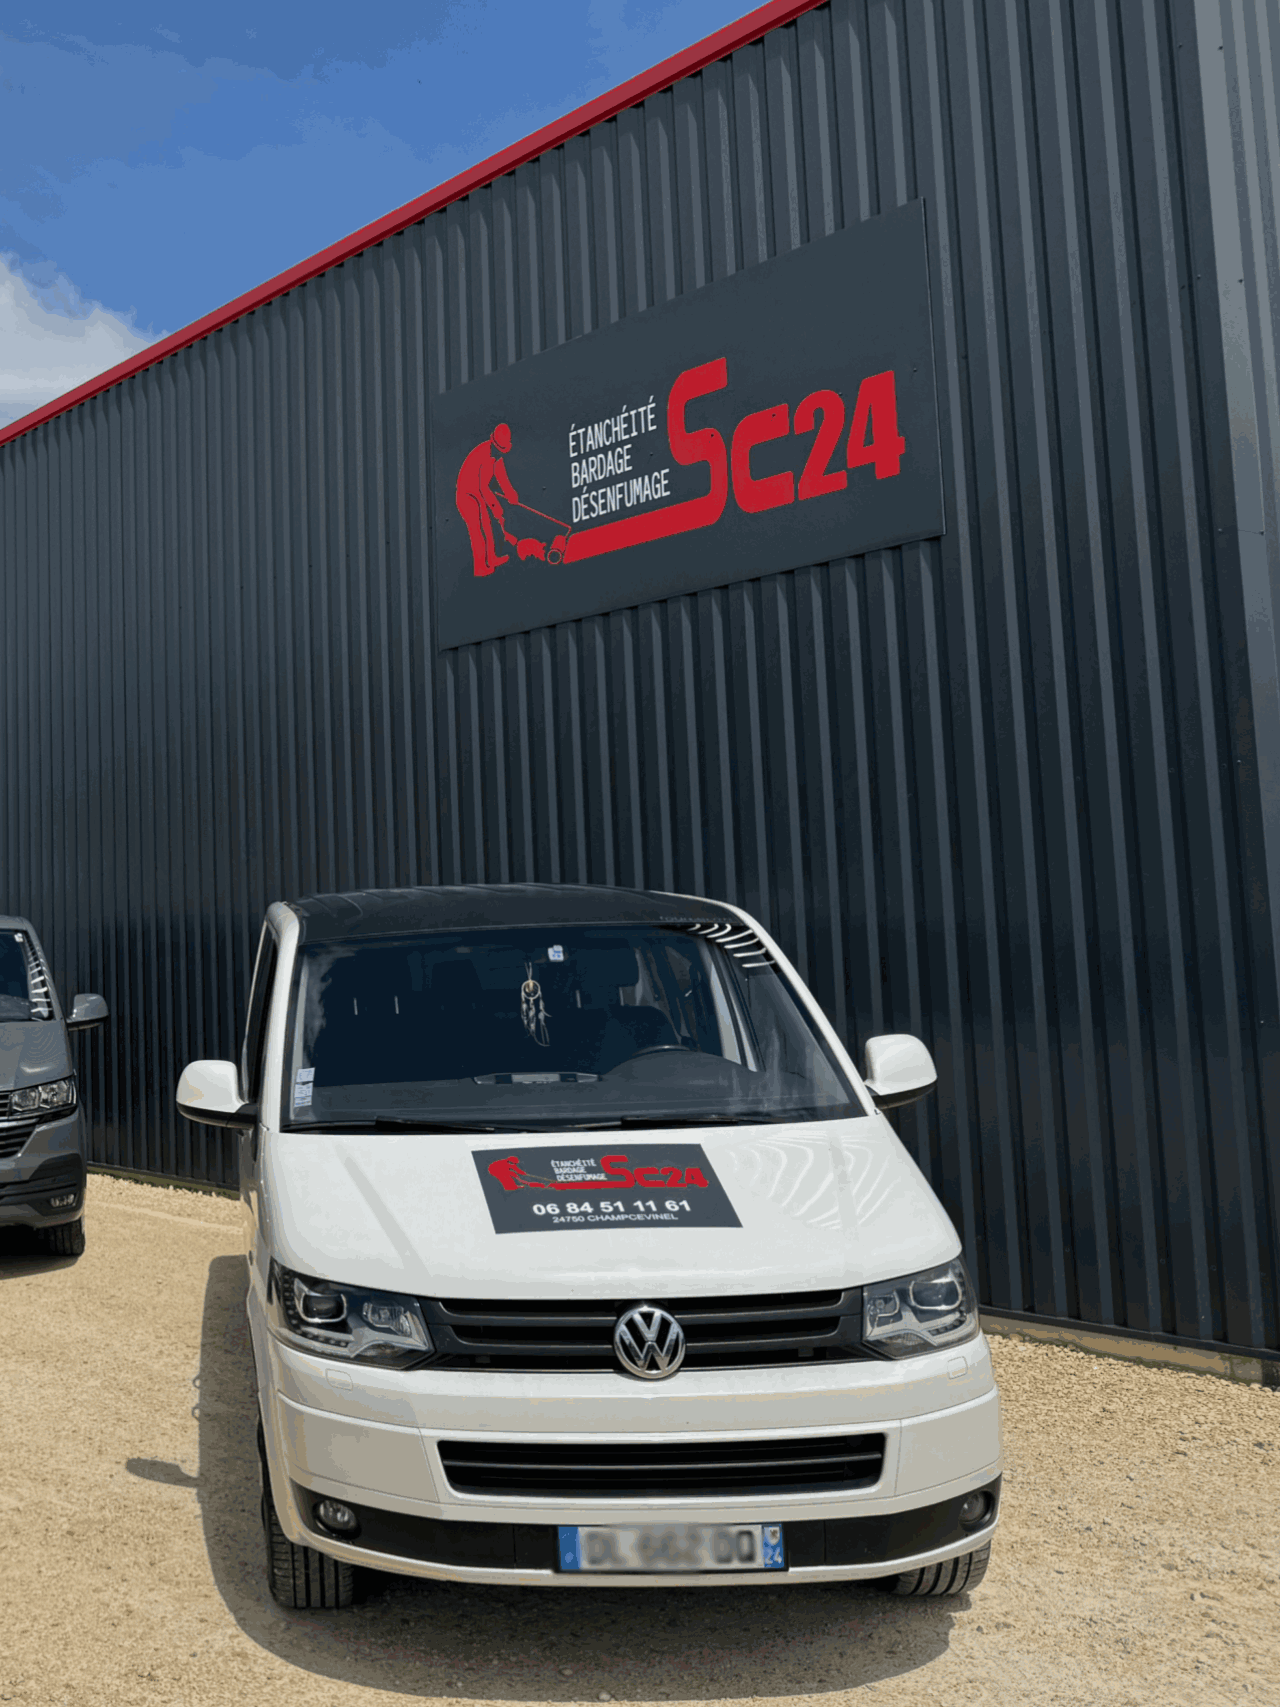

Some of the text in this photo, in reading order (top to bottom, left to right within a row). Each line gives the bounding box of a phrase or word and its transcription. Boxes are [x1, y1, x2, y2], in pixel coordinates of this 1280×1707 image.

[568, 394, 657, 458] ÉTANCHÉITÉ
[571, 443, 633, 488] BARDAGE
[572, 468, 671, 523] DÉSENFUMAGE
[532, 1200, 691, 1215] 06 84 51 11 61
[552, 1213, 678, 1223] 24750 CHAMPCEVINEL
